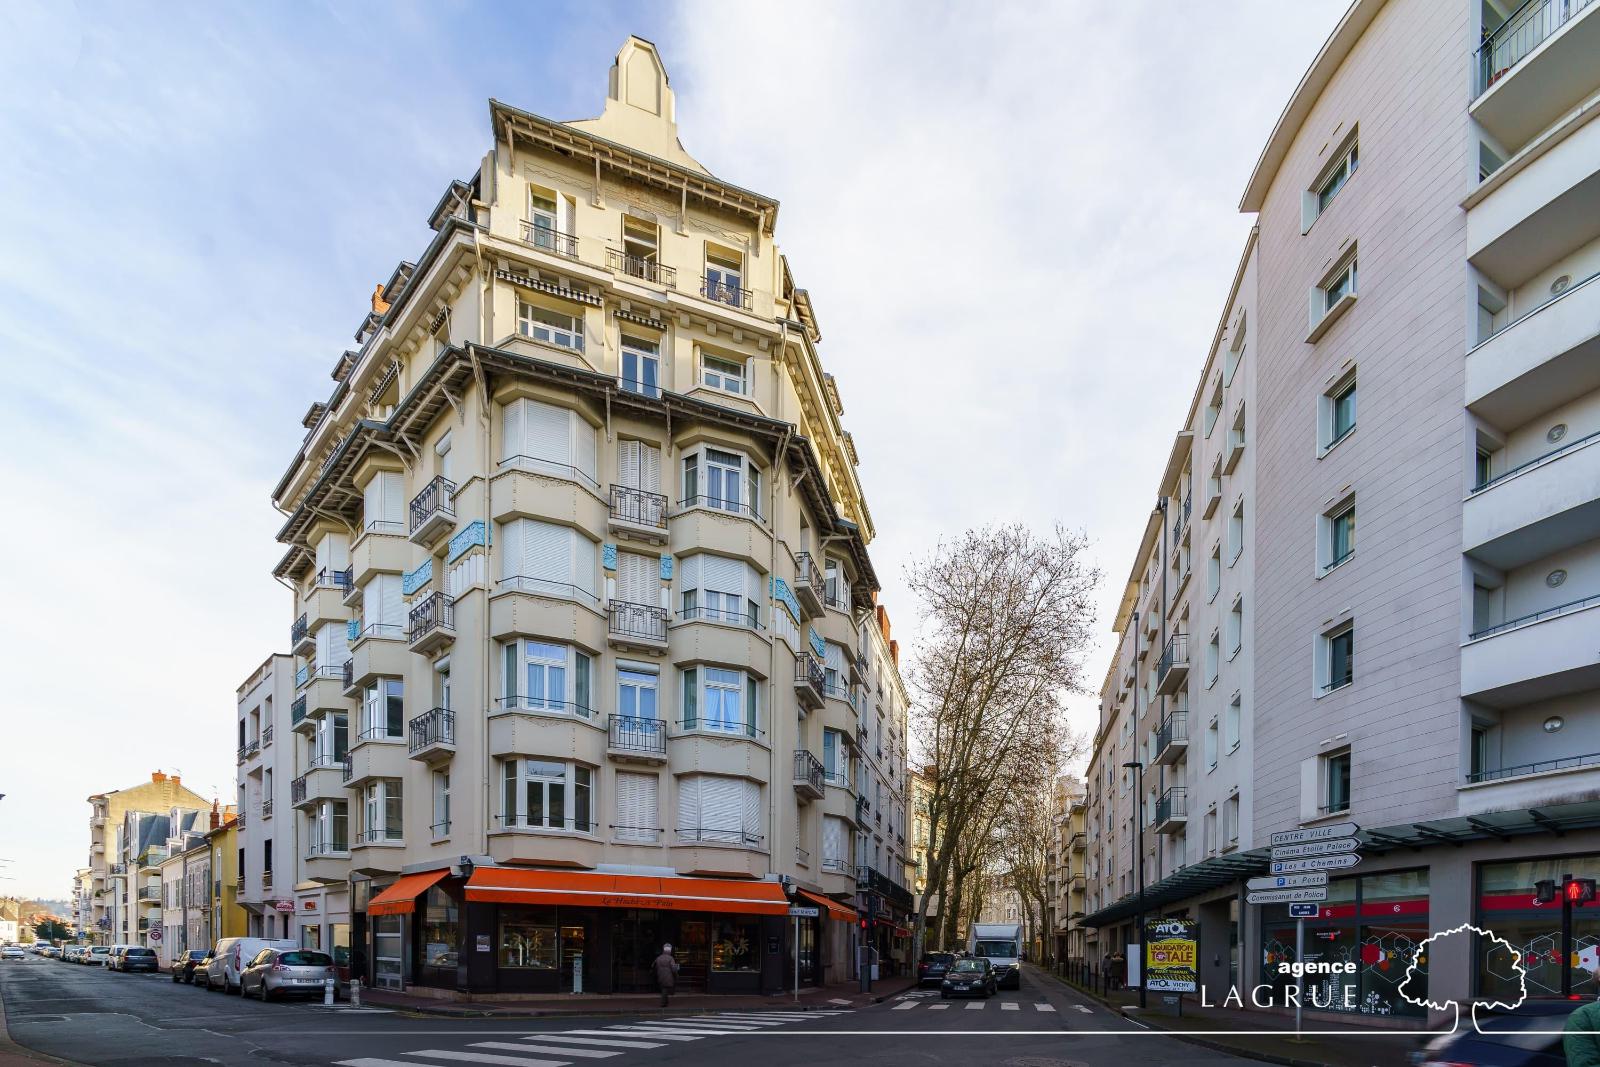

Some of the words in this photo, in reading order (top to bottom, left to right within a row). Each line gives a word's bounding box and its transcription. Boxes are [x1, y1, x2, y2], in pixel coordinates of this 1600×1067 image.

[1274, 834, 1304, 842] CENTRE
[1310, 829, 1332, 838] VILLE
[1311, 858, 1347, 867] Chemins
[1156, 923, 1188, 934] ATOL
[1150, 951, 1193, 963] TOTALE
[1149, 979, 1171, 988] ATOL
